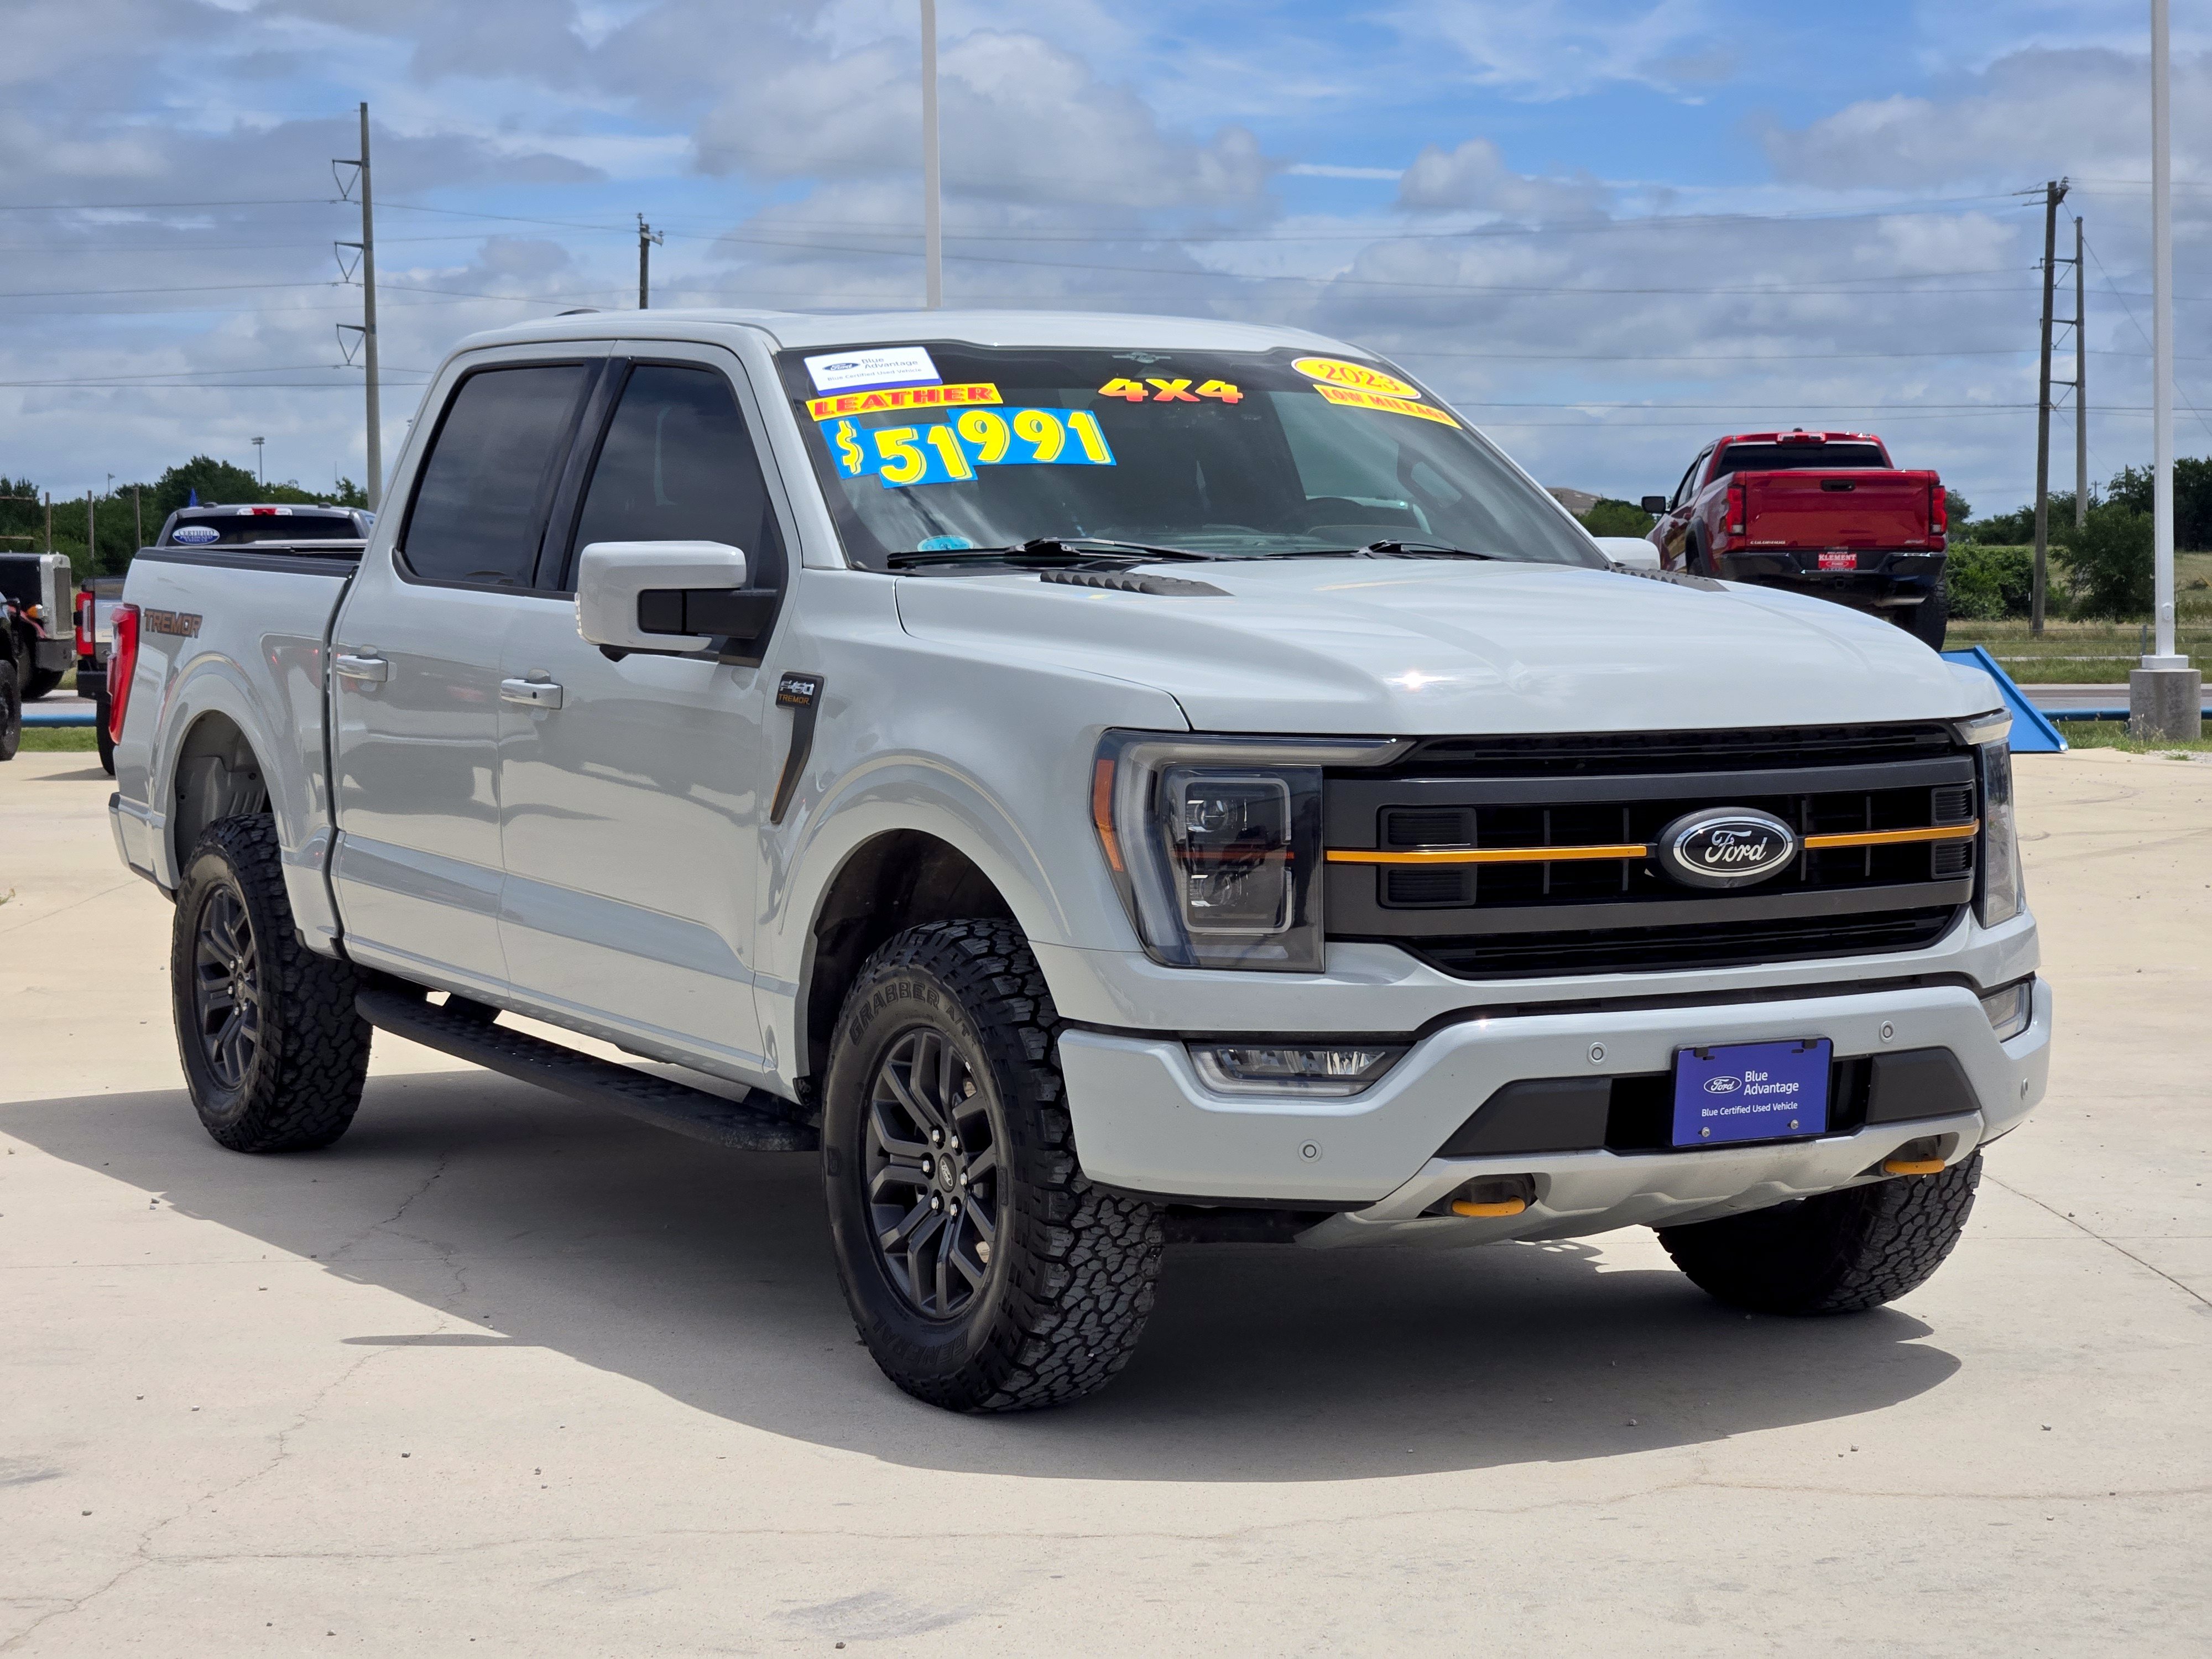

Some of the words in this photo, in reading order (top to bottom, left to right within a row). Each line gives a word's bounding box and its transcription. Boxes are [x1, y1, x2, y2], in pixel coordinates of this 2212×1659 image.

[864, 360, 919, 369] Advantage
[1318, 364, 1400, 392] 2023
[814, 387, 993, 416] LEATHER
[1320, 388, 1365, 404] LOW
[144, 608, 202, 639] TREMOR
[778, 693, 811, 705] TREMOR
[1705, 830, 1768, 863] Ford
[849, 982, 940, 1046] GRABBER
[1744, 1070, 1768, 1083] Blue
[1710, 1078, 1735, 1091] Ford
[1744, 1081, 1799, 1095] Advantage
[1701, 1108, 1718, 1117] Blue
[1720, 1106, 1751, 1115] Certified
[1752, 1104, 1771, 1113] Used
[1772, 1102, 1798, 1111] Vehicle
